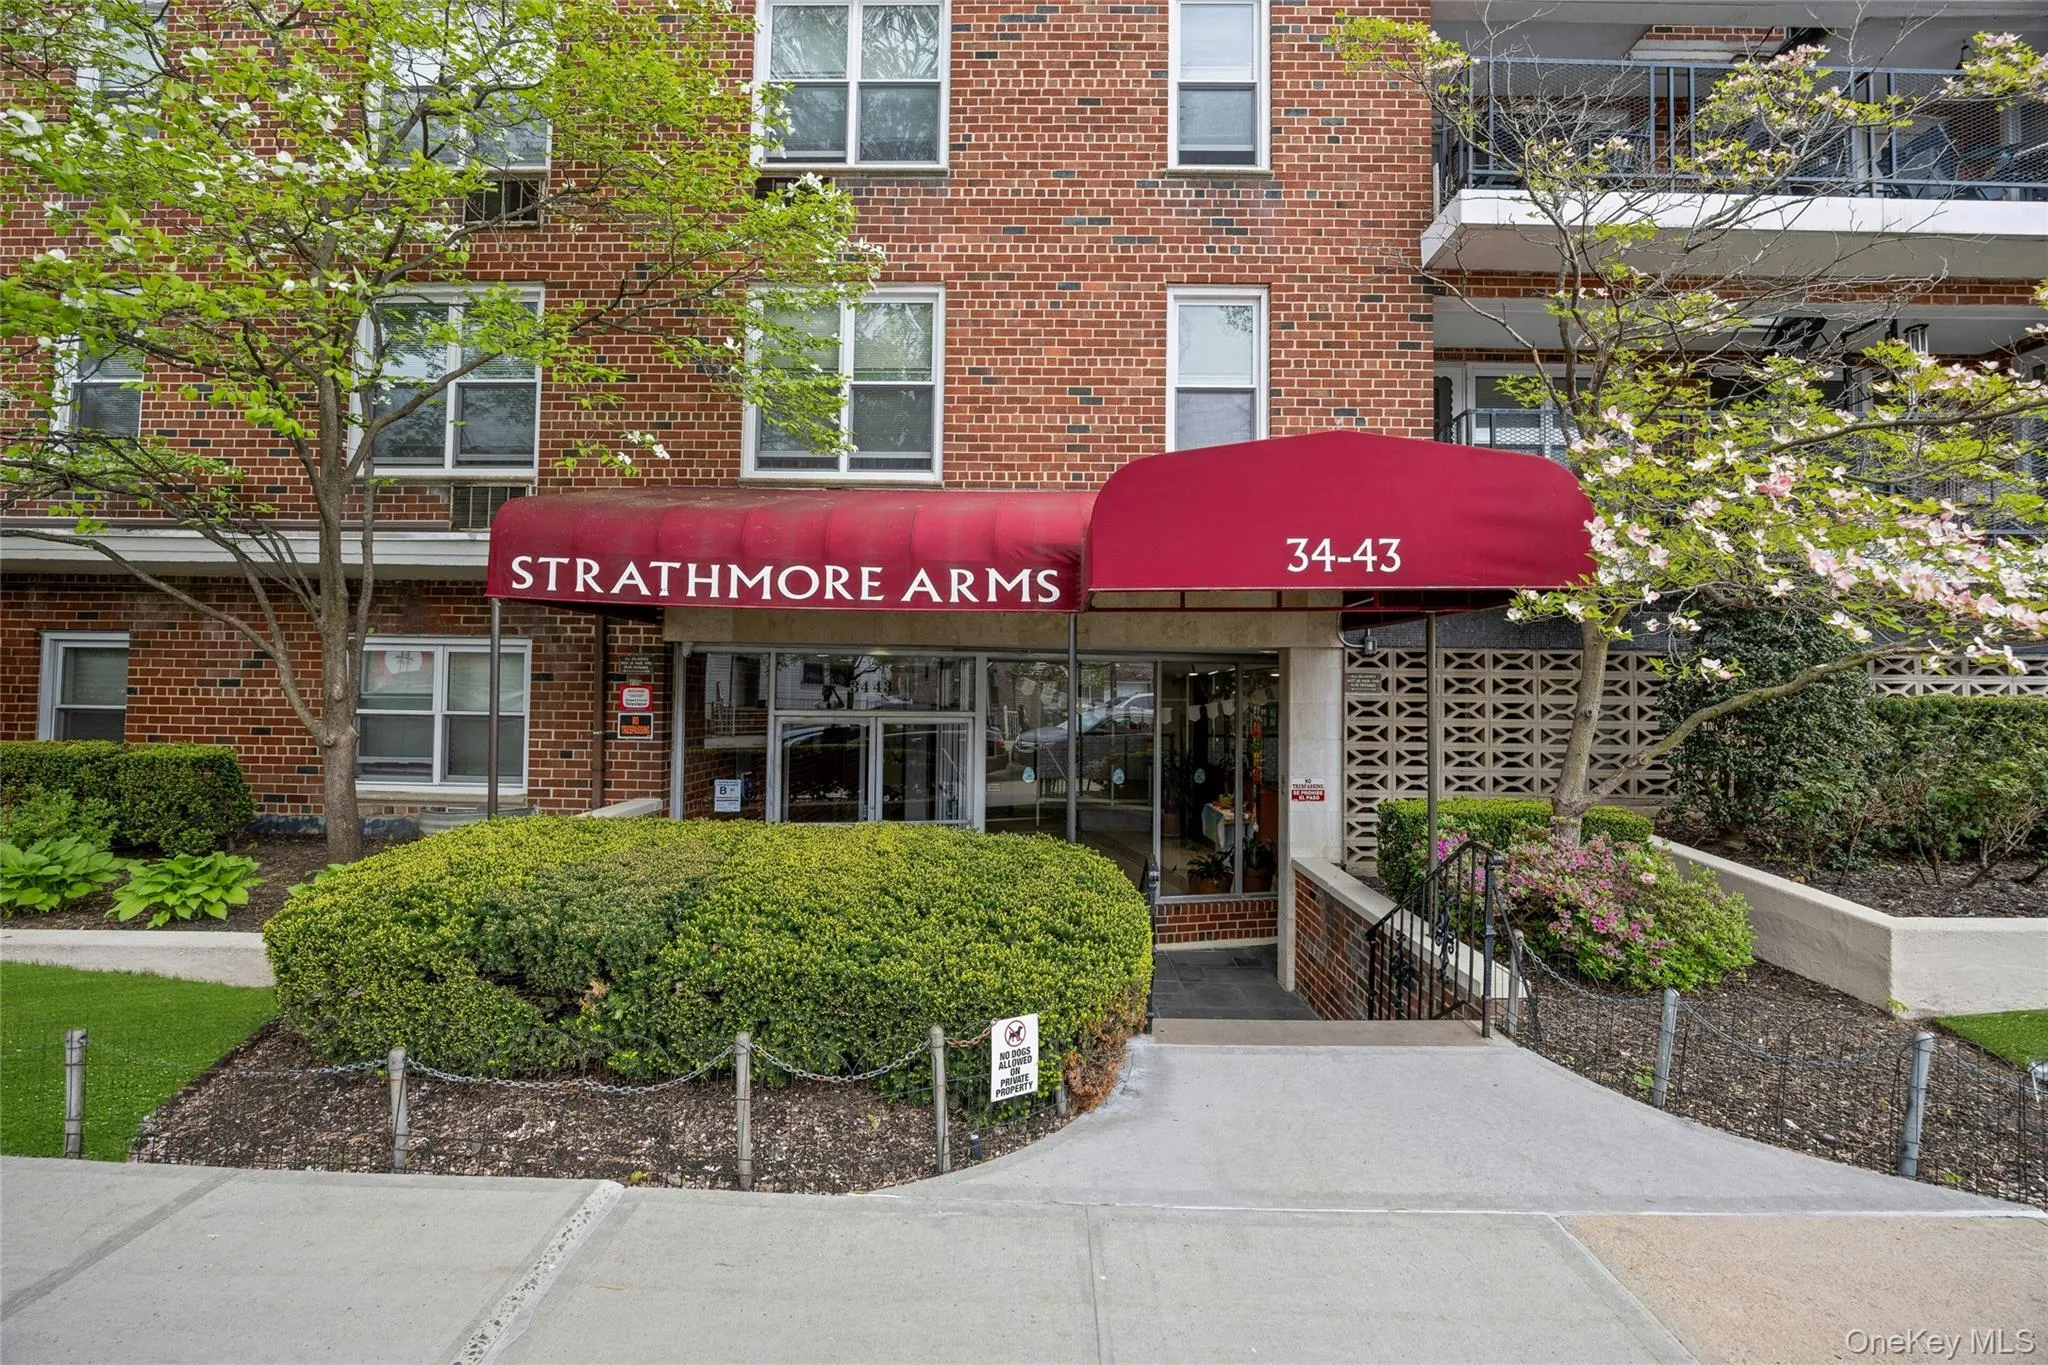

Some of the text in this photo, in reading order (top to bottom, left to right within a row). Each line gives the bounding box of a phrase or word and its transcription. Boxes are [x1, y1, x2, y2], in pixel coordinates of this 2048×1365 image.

[1286, 538, 1401, 572] 34-43
[511, 555, 1061, 603] STRATHMORE ARMS
[1000, 1046, 1031, 1061] NO DOGS
[998, 1055, 1032, 1070] ALLOWED
[1010, 1067, 1020, 1076] ON
[1000, 1073, 1029, 1087] PRIVATE
[996, 1081, 1033, 1097] PROPERTY
